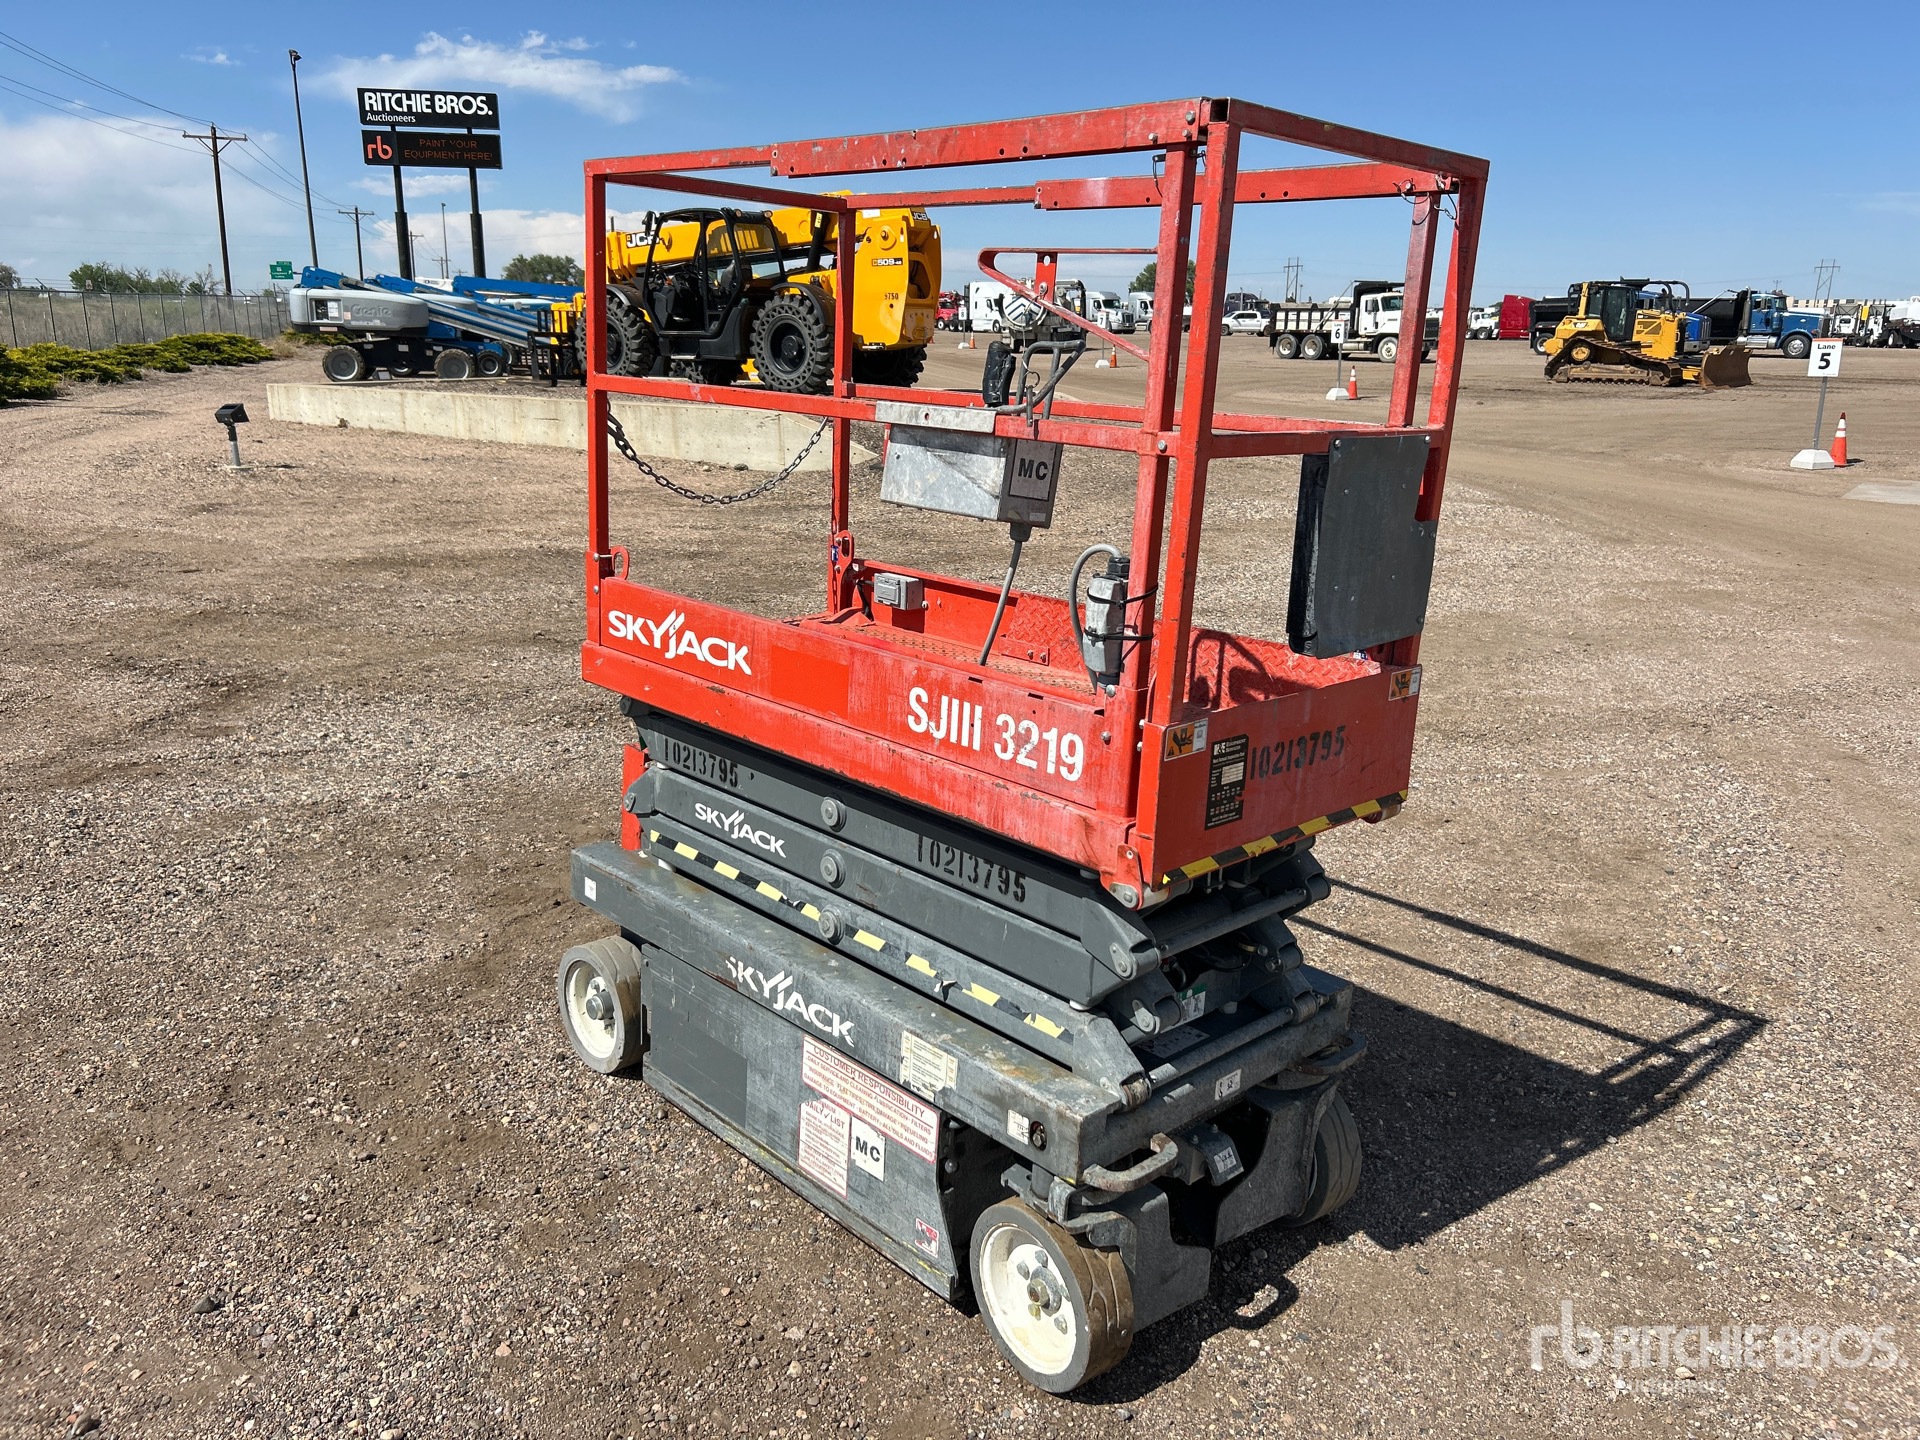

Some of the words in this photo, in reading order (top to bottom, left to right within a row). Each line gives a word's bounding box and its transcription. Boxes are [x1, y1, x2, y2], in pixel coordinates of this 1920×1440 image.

[364, 92, 432, 113] RITCHIE
[435, 95, 493, 115] BROS.
[367, 113, 416, 123] Auctioneers
[367, 135, 393, 160] rb
[404, 150, 461, 160] EQUIPMENT
[464, 152, 493, 161] HERE!
[419, 139, 446, 148] PAINT
[450, 140, 478, 149] YOUR
[913, 212, 928, 220] JCB
[1100, 317, 1104, 325] 7
[1335, 328, 1340, 339] 6
[1818, 352, 1831, 370] 5
[1018, 457, 1048, 480] MC
[608, 609, 752, 676] SKYJACK
[994, 713, 1084, 782] 3219
[1249, 725, 1346, 780] 10213795
[665, 737, 738, 788] 10213795
[694, 802, 787, 859] SKYJACK
[917, 833, 1026, 903] 10213795
[725, 956, 855, 1048] SKYJACK
[813, 1045, 855, 1077] CUSTOMER
[857, 1071, 924, 1119] RESPONSIBILITY
[830, 1114, 846, 1129] LIST
[855, 1136, 881, 1163] MC
